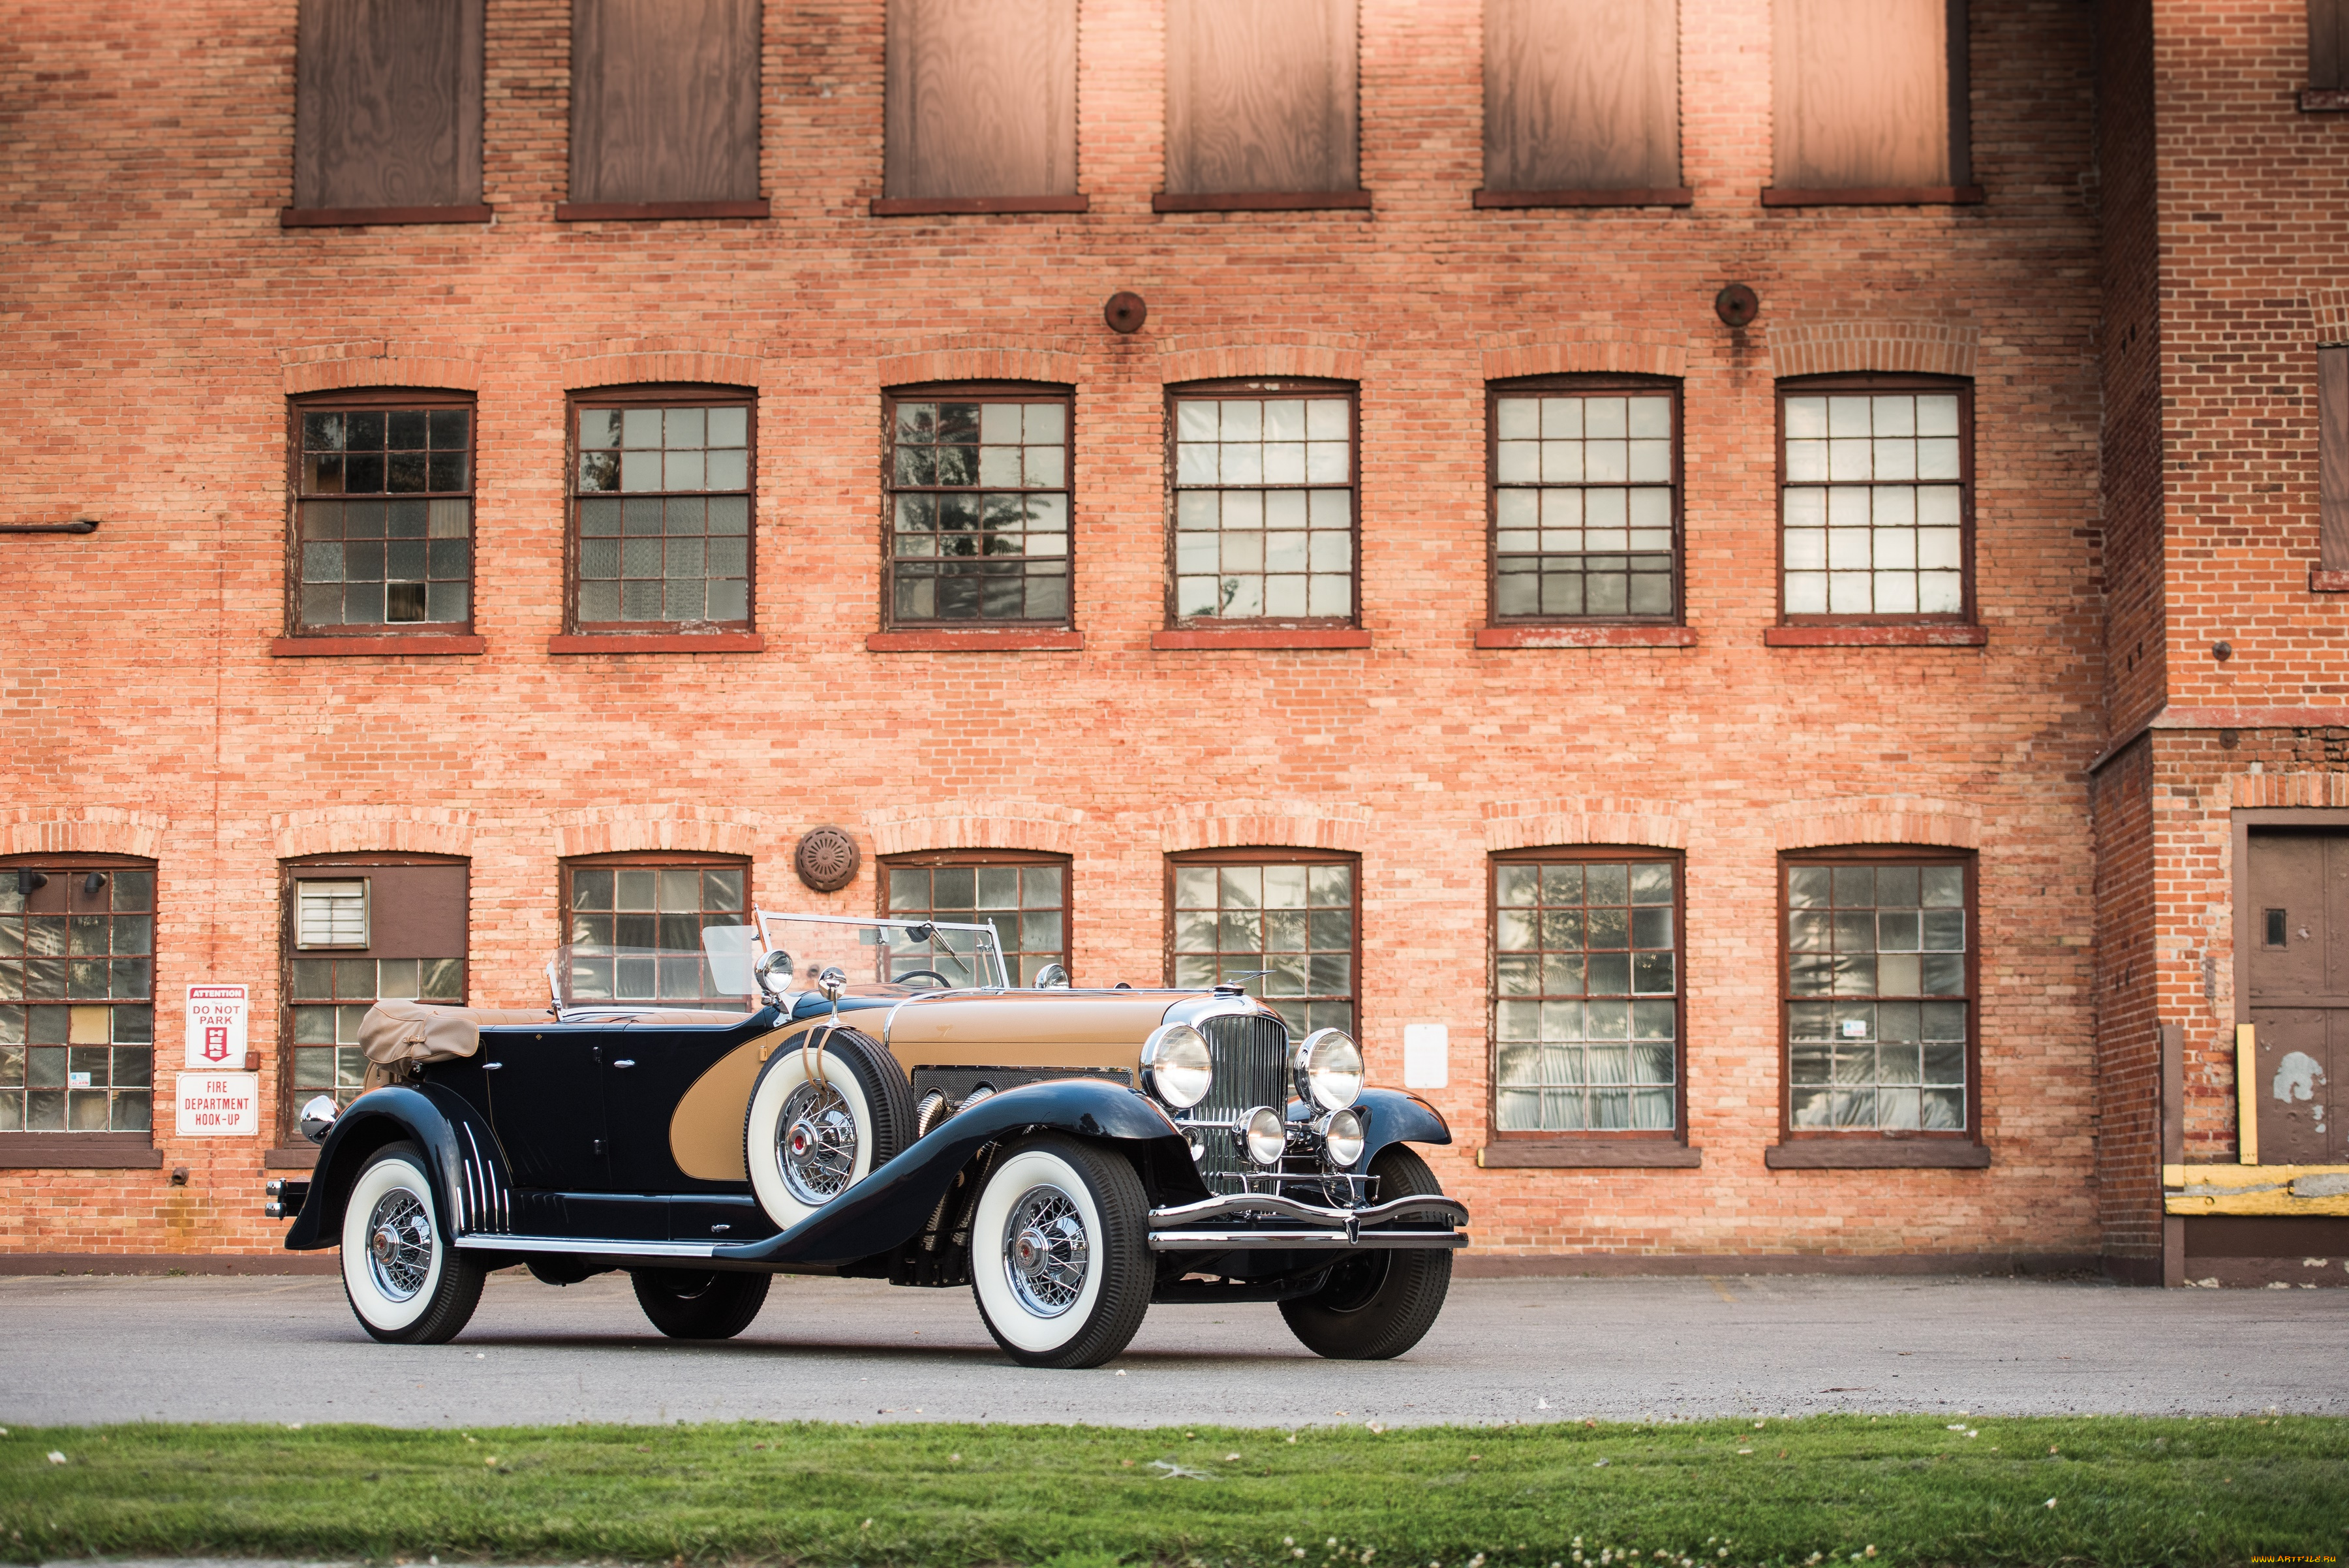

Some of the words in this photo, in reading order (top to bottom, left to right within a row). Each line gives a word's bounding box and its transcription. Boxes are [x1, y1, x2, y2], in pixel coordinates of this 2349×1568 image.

[215, 1006, 240, 1014] NOT
[200, 1016, 232, 1024] PARK
[209, 1030, 224, 1058] HERE
[207, 1081, 227, 1093] FIRE
[185, 1098, 249, 1110] DEPARTMENT
[195, 1113, 240, 1126] HOOK-UP
